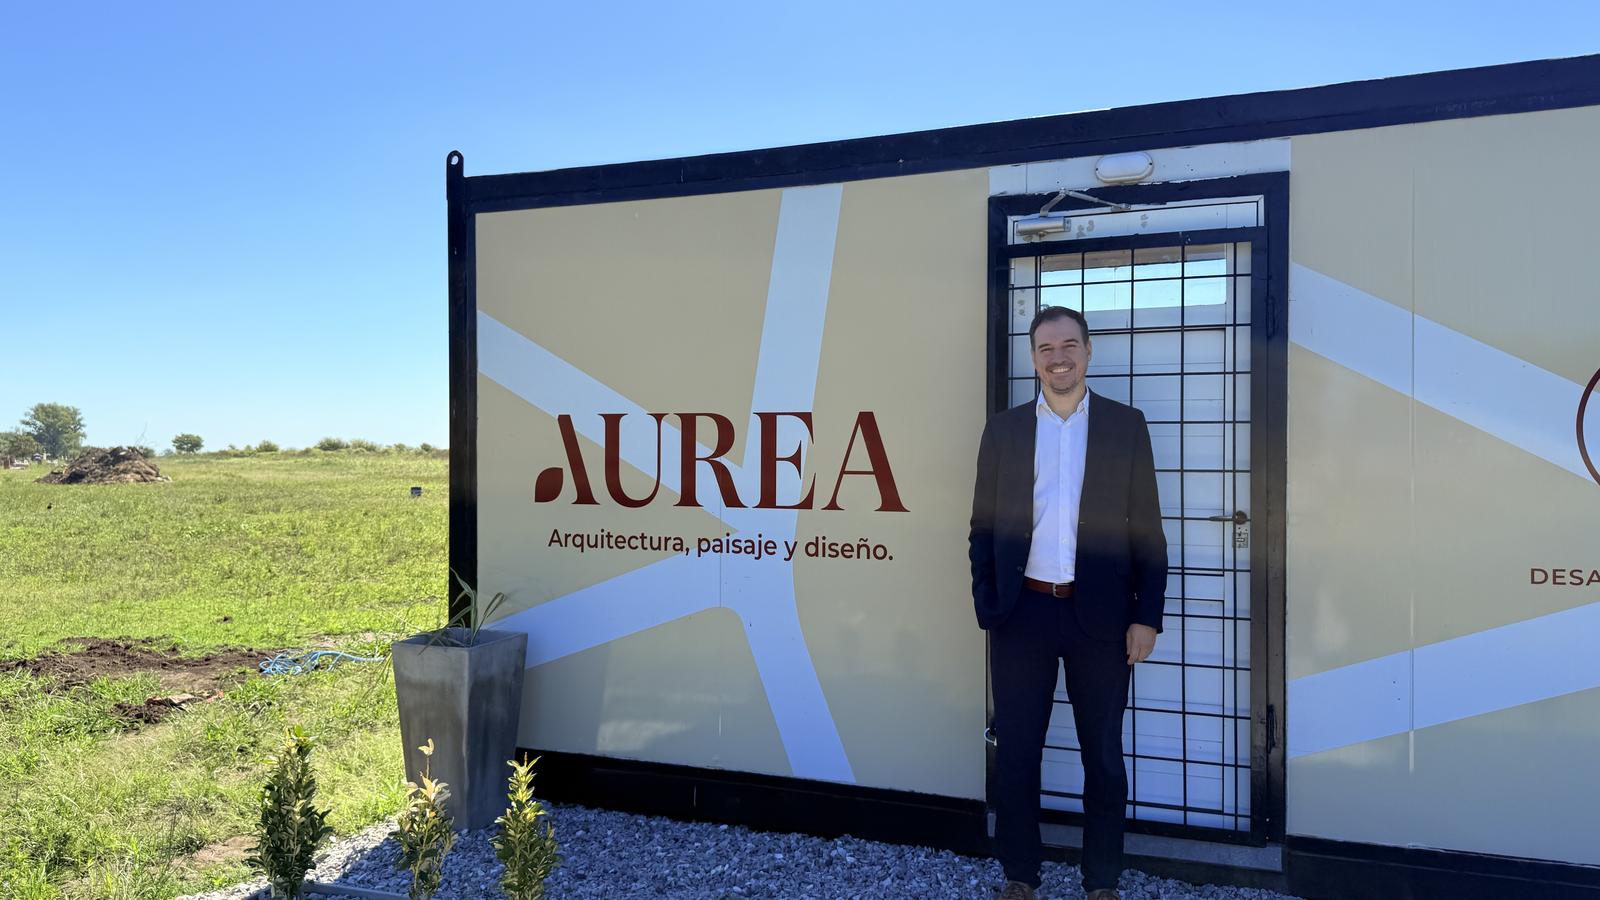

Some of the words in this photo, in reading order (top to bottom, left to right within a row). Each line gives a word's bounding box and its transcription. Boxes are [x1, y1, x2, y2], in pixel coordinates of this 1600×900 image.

[535, 411, 911, 513] AUREA
[548, 529, 691, 556] Arquitectura,
[697, 533, 777, 561] paisaje
[783, 539, 798, 562] y
[804, 536, 894, 561] diseño.
[1530, 567, 1600, 586] DESA
